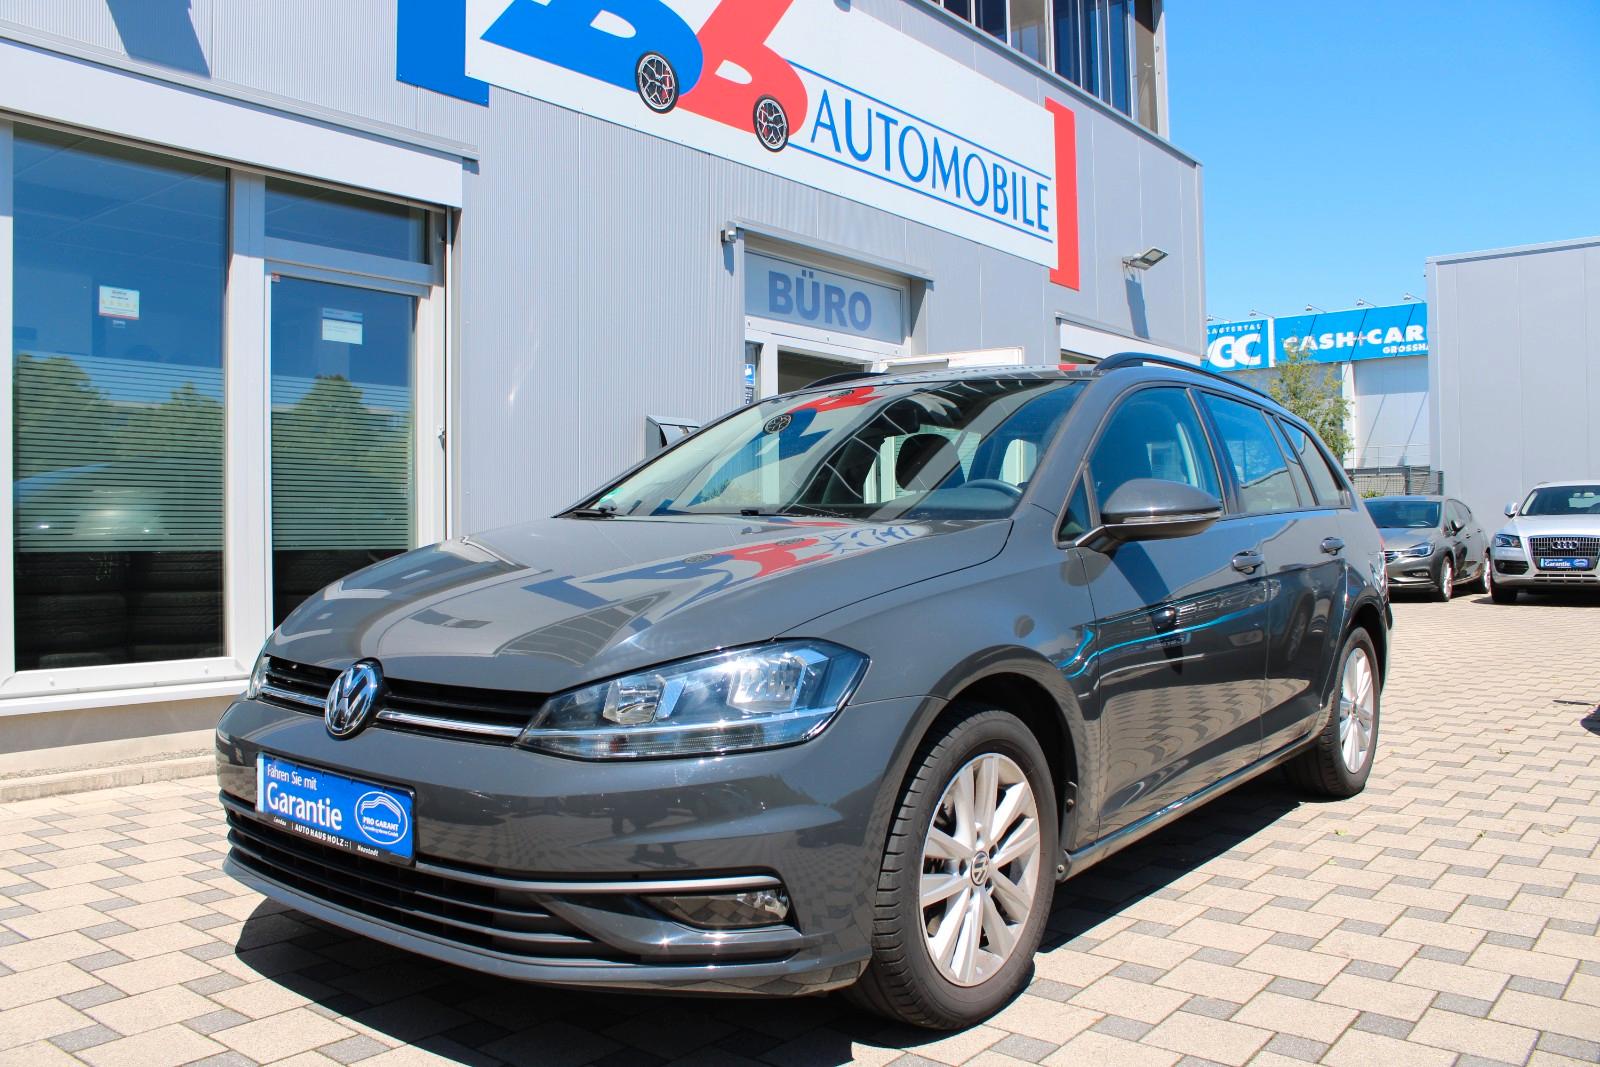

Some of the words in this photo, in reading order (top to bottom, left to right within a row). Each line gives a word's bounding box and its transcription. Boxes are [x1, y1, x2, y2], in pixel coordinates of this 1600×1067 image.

[811, 89, 1049, 232] AUTOMOBILE
[769, 270, 871, 331] BÜRO
[267, 764, 289, 782] Fahren
[292, 771, 302, 786] Sie
[304, 777, 317, 791] mit
[267, 782, 342, 830] Garantie
[363, 816, 374, 826] PRO
[375, 819, 399, 831] GARANT
[327, 834, 344, 847] HOLZ
